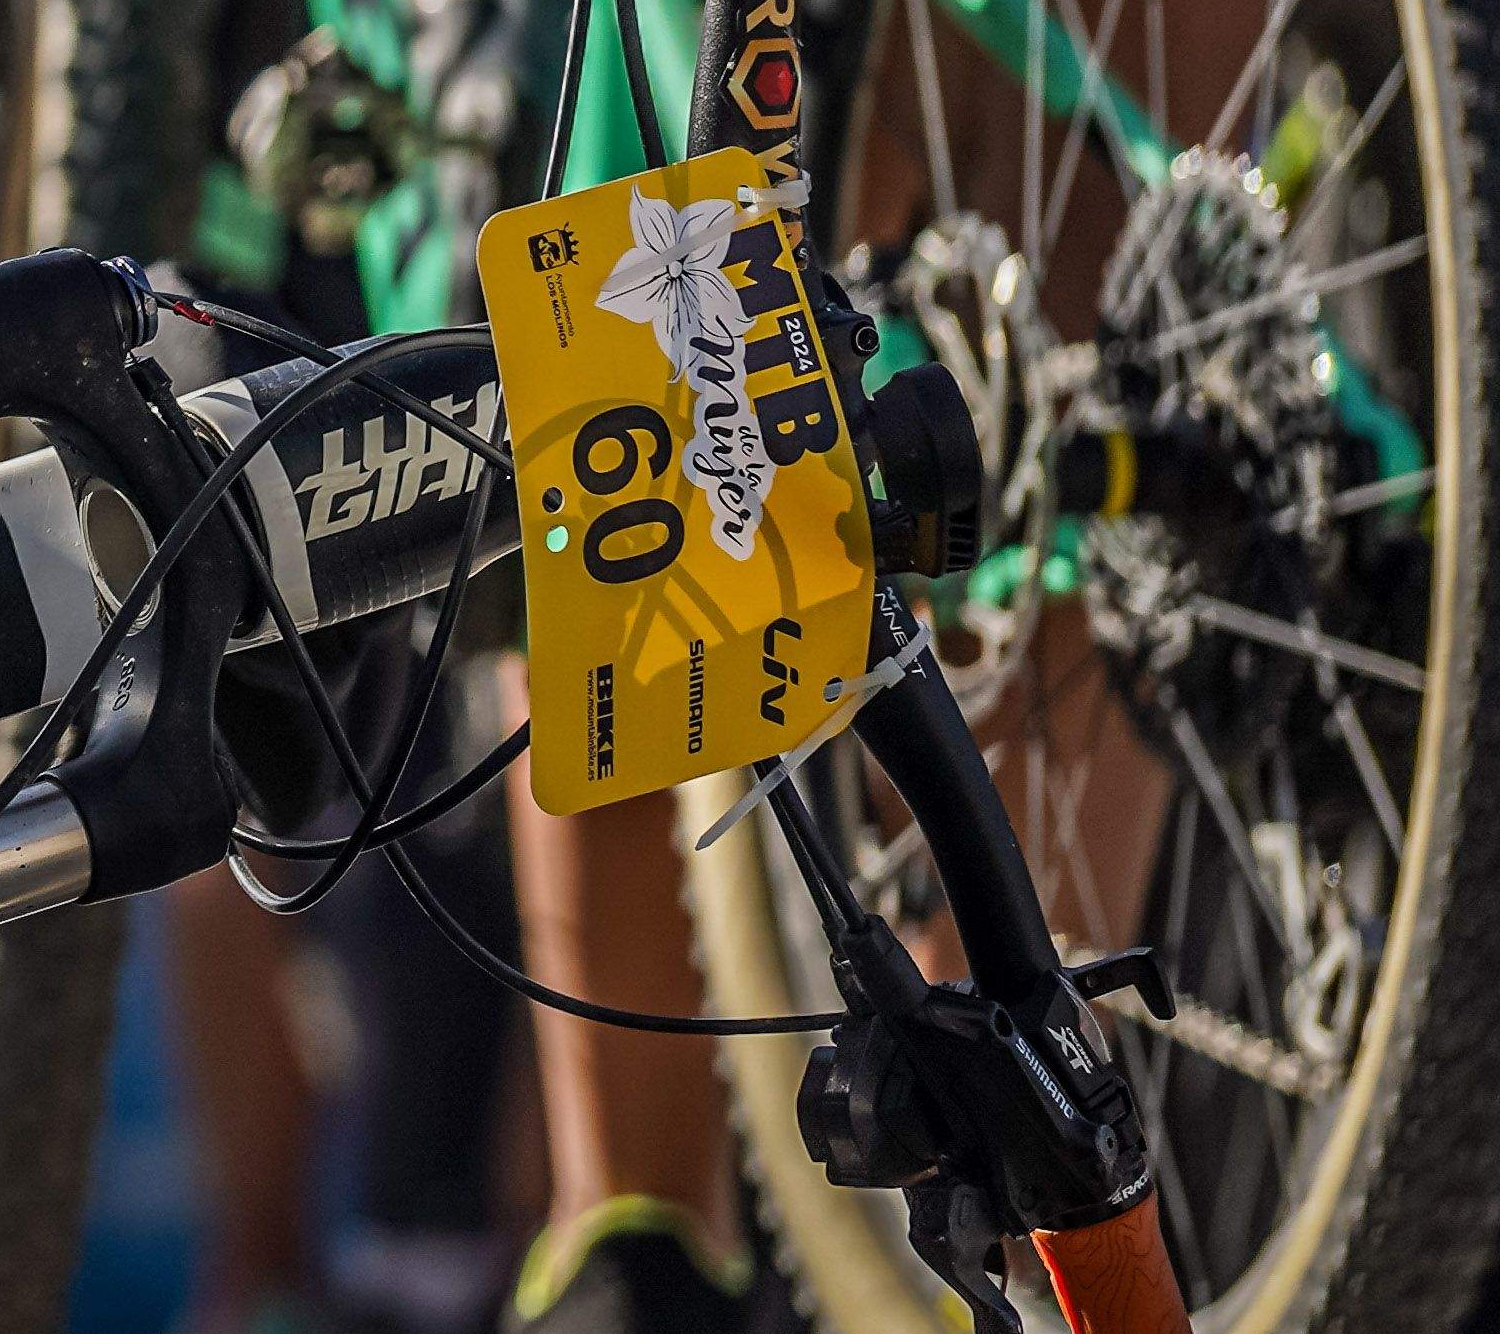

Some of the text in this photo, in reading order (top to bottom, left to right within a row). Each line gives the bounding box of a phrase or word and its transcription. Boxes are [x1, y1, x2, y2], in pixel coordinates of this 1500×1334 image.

[546, 275, 568, 348] LOS MOLINOS
[556, 273, 575, 337] Ayuntamiento
[719, 220, 839, 466] MTB
[786, 318, 813, 371] 2024
[574, 405, 684, 584] 60
[738, 425, 762, 492] de la
[688, 639, 704, 755] SHIMANO
[760, 617, 802, 726] Liv
[597, 663, 614, 780] BIKE
[1016, 1037, 1074, 1119] SHIMANO
[1047, 1026, 1091, 1074] XT
